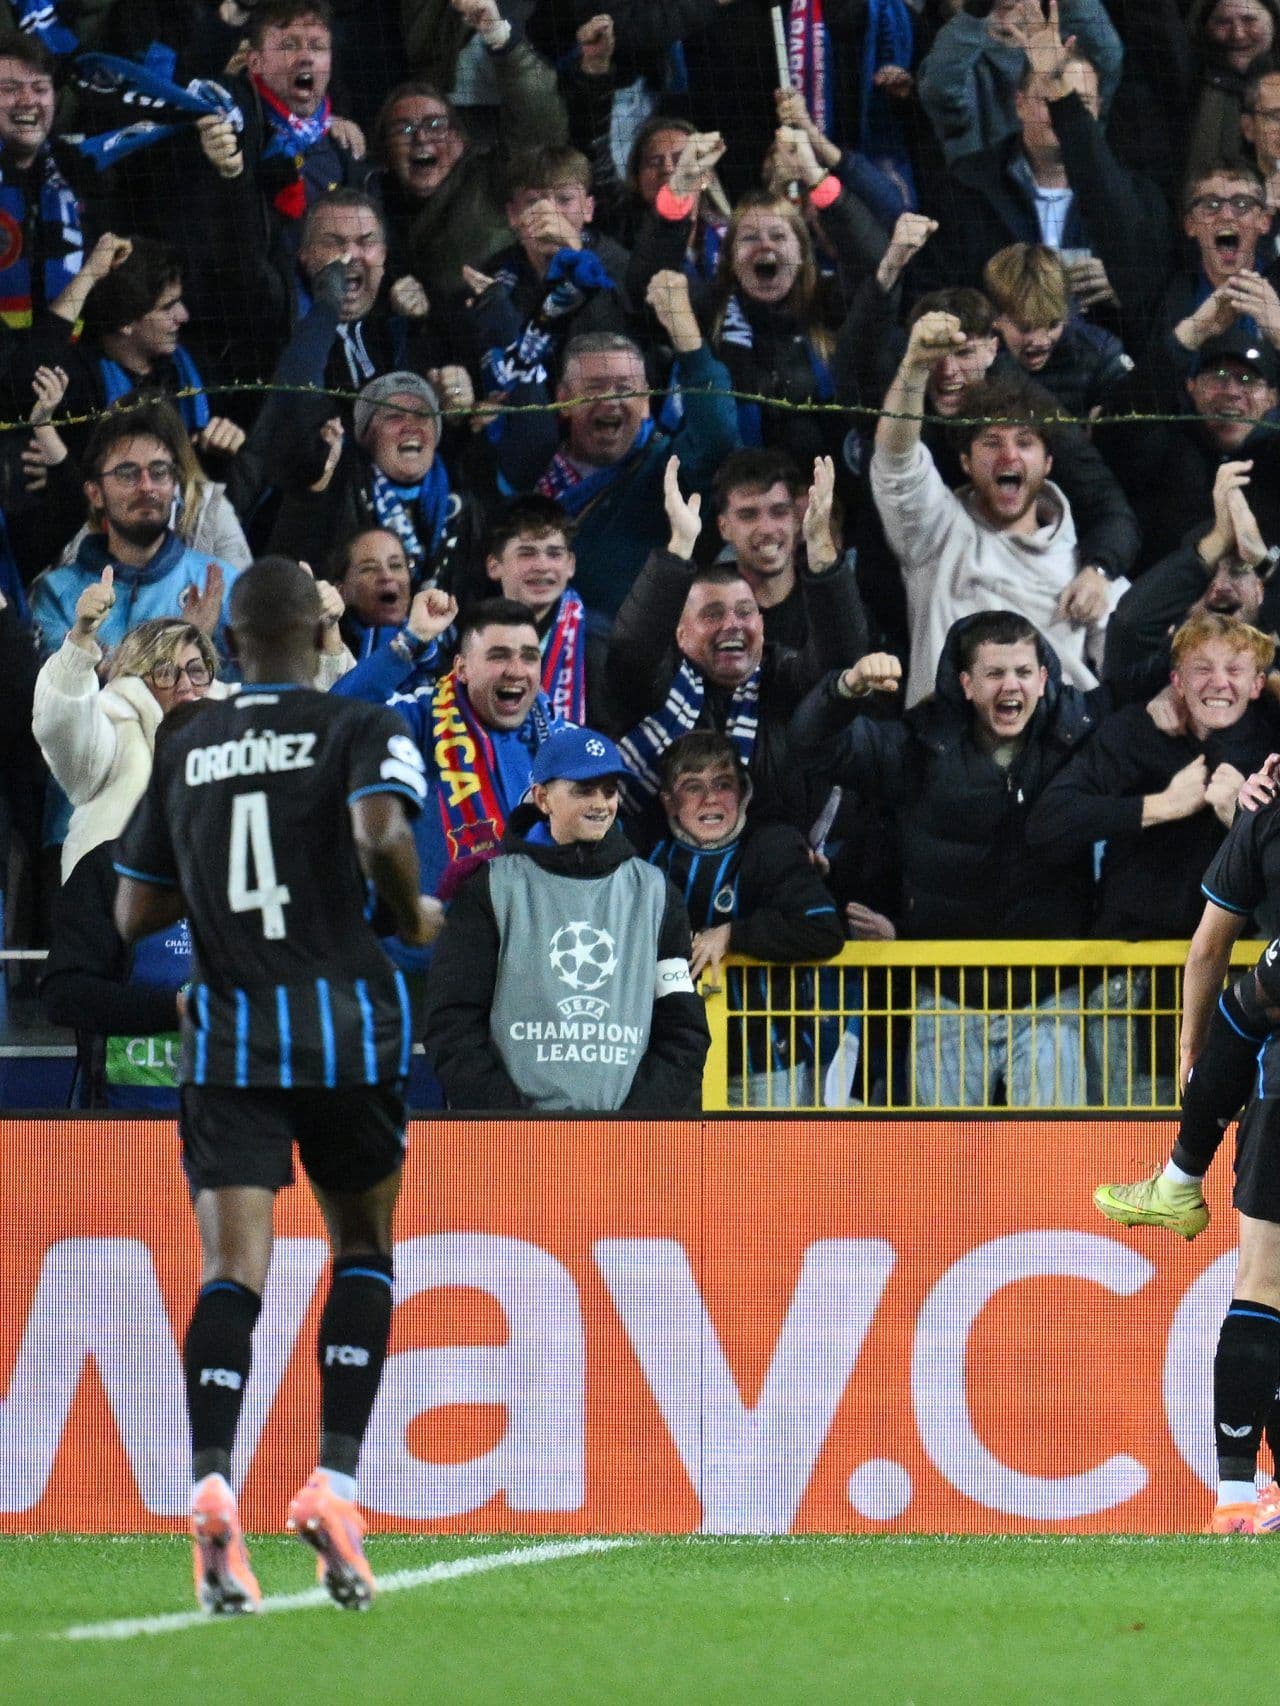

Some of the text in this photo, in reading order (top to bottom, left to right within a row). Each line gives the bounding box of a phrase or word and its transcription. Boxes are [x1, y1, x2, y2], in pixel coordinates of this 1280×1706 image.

[227, 790, 292, 941] 4
[559, 997, 607, 1019] UEFA
[536, 1043, 630, 1066] LEAGUE
